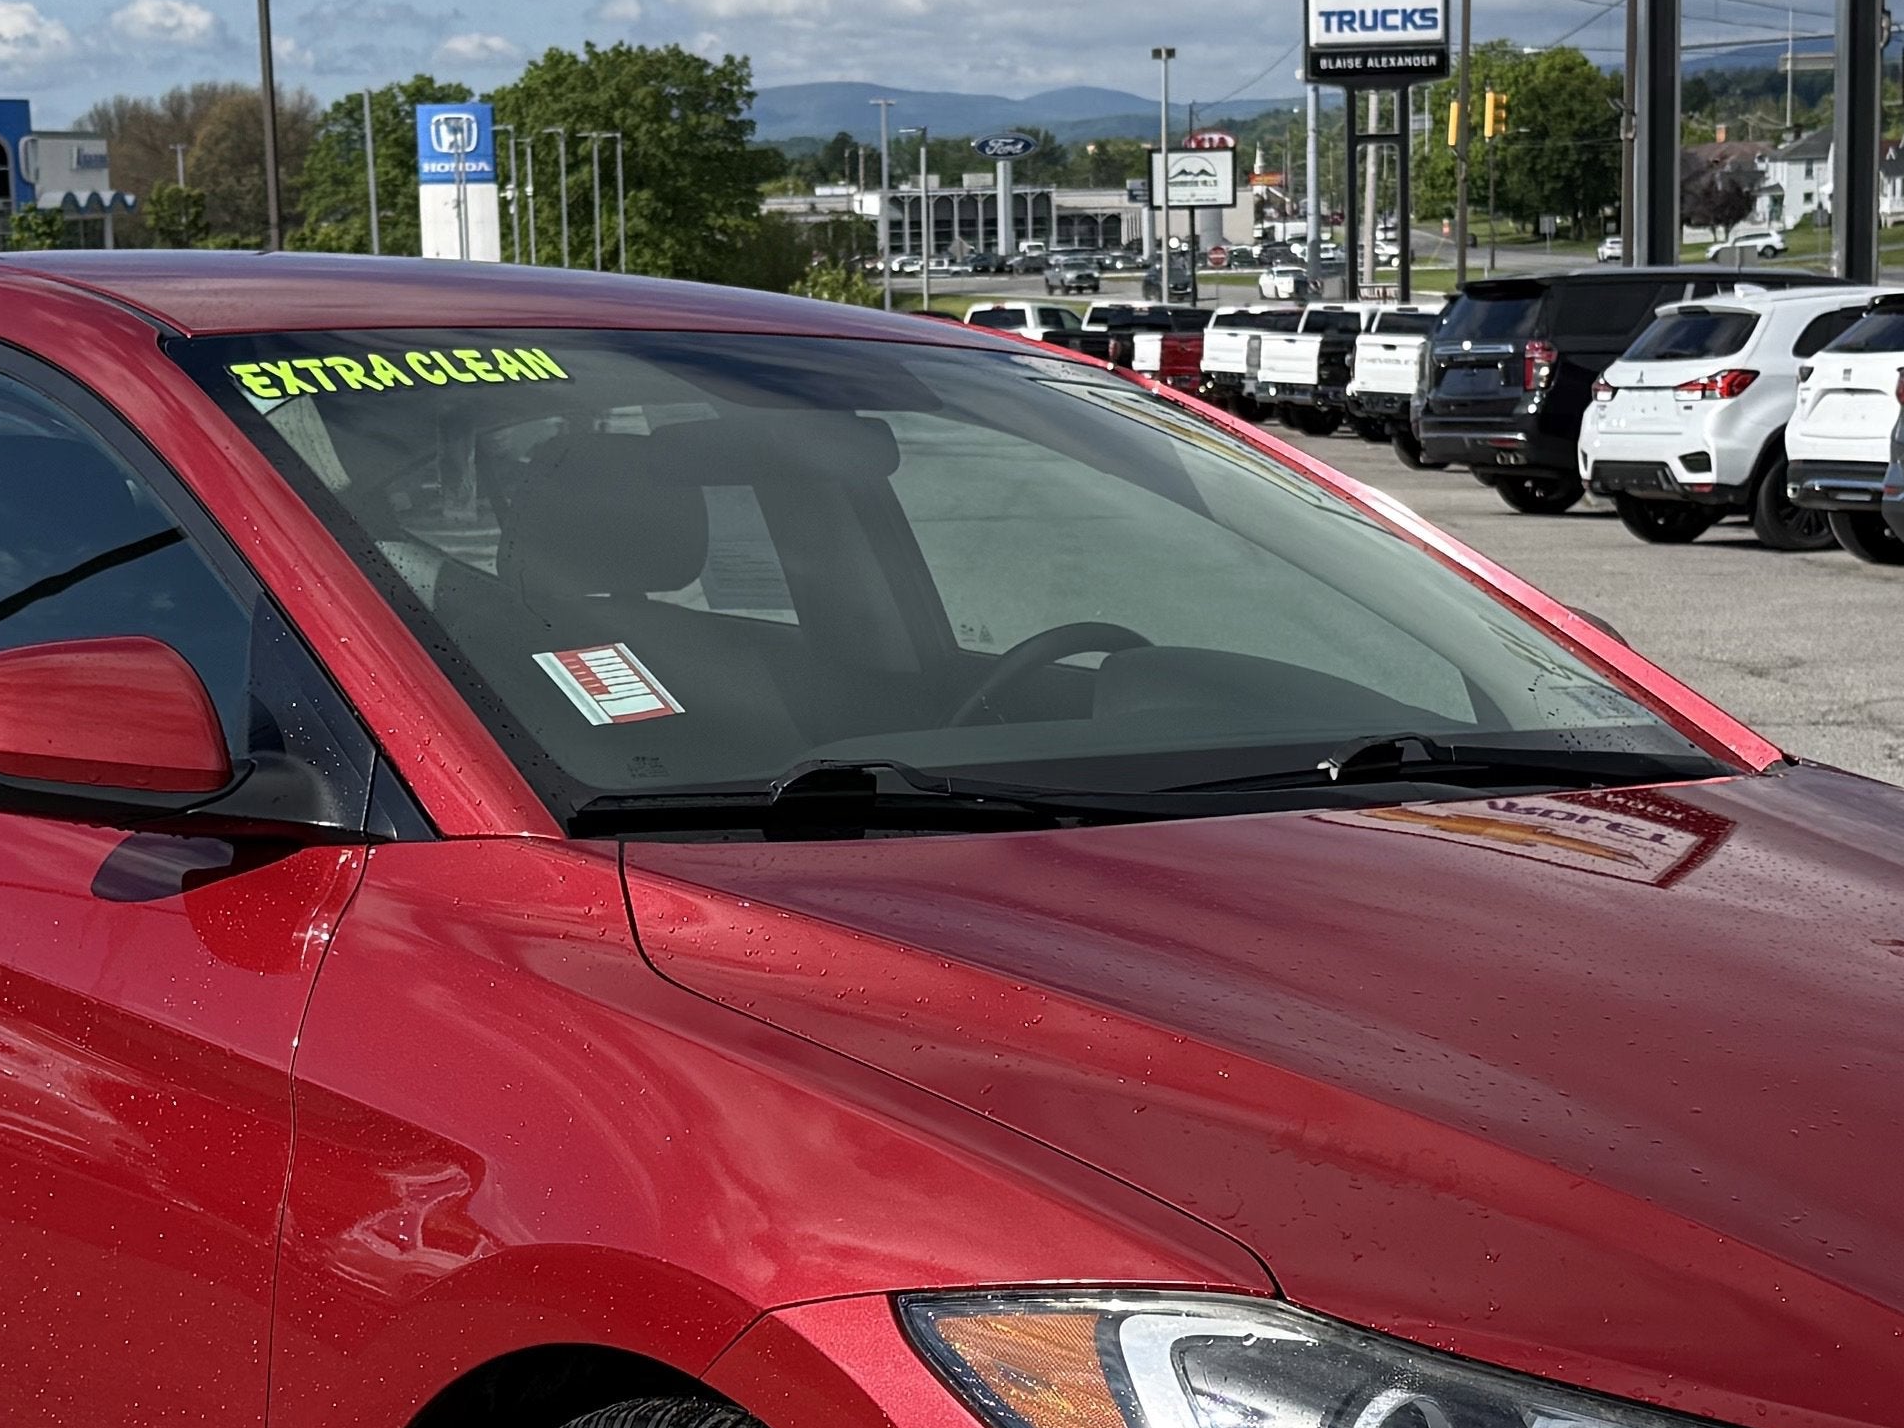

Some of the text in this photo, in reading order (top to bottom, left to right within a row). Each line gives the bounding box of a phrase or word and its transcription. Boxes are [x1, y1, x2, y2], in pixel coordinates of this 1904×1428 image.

[1318, 7, 1439, 33] TRUCKS
[1319, 55, 1437, 70] BLAISE ALEXANDER
[984, 138, 1026, 155] Ford
[229, 348, 570, 399] EXTRA CLEAN
